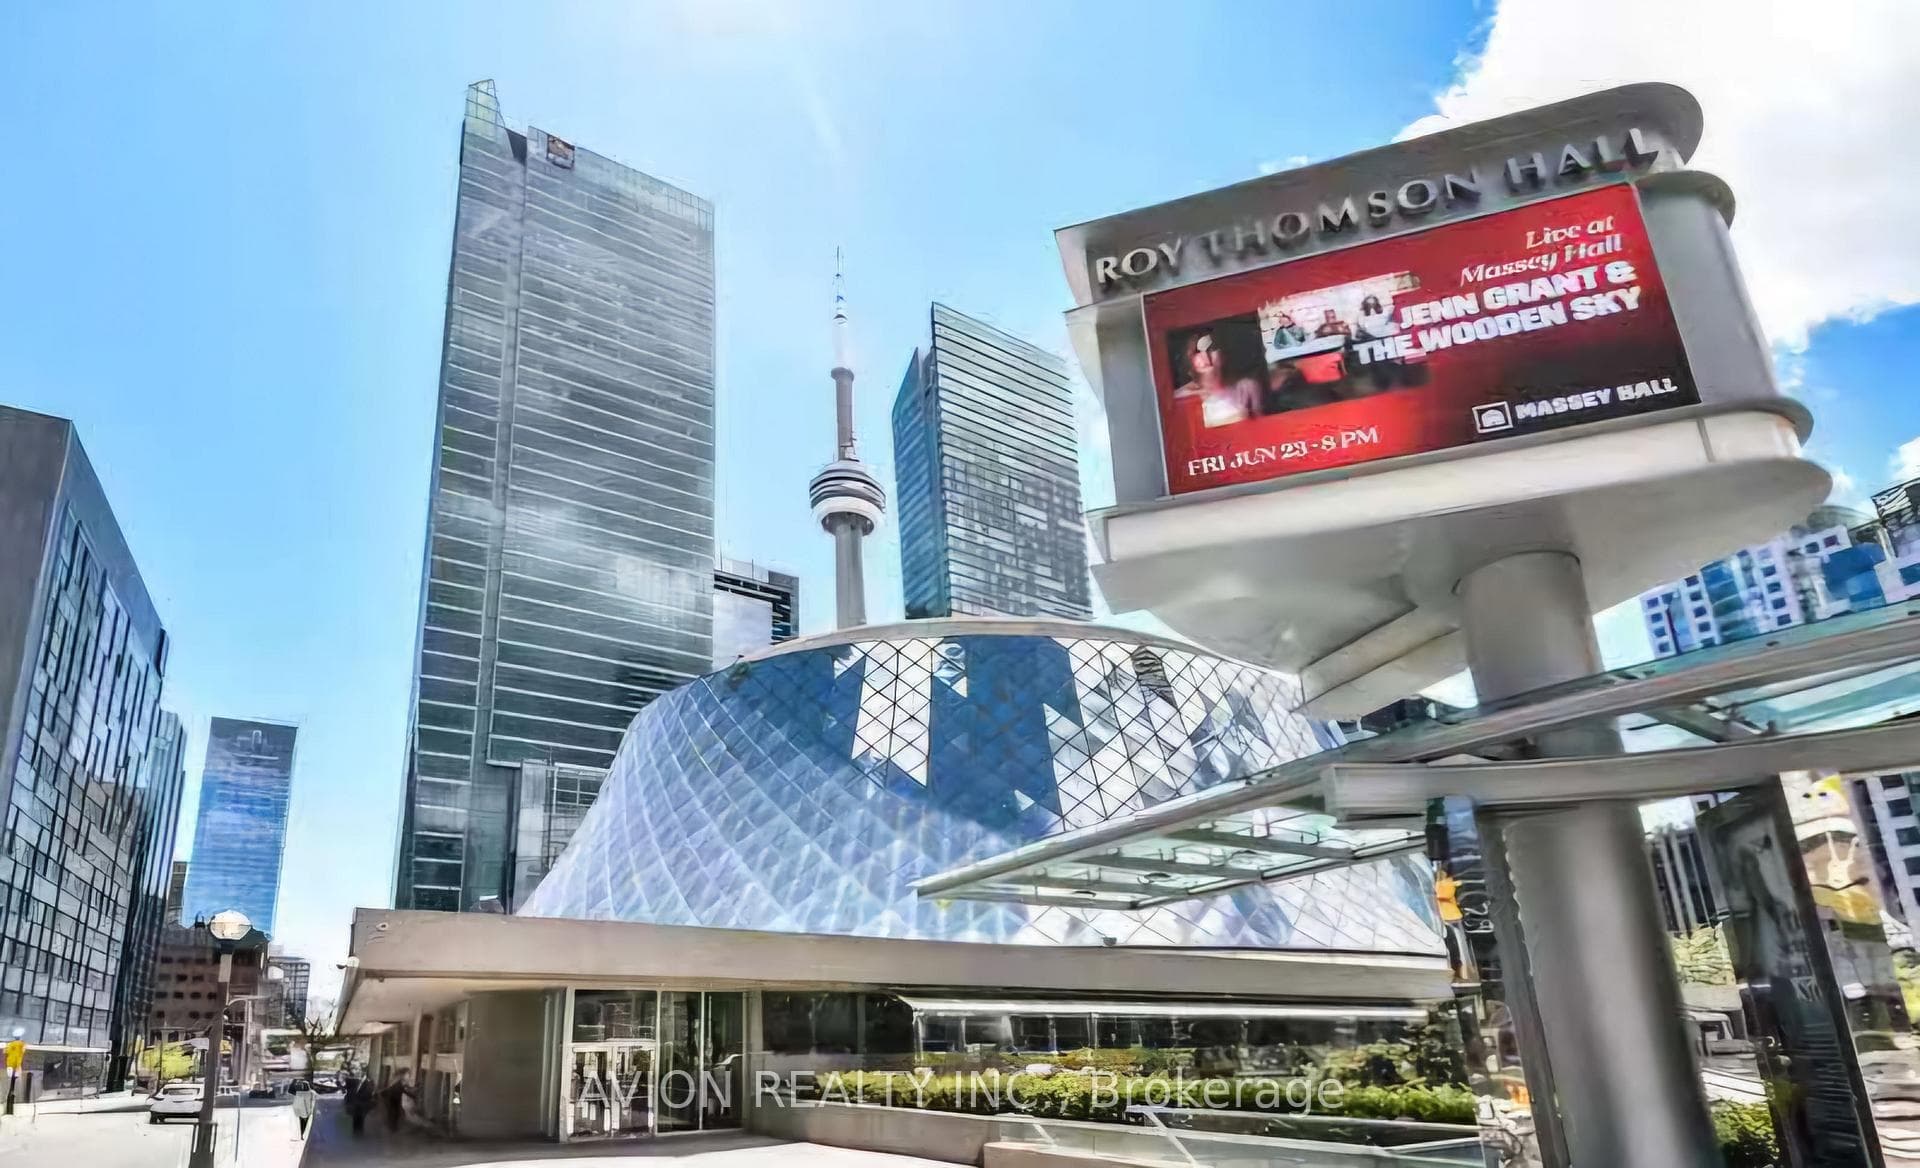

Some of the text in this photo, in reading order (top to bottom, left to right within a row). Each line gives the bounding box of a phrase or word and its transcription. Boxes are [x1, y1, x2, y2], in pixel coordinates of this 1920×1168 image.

[1096, 127, 1660, 284] ROY THOMSON HALL
[1526, 216, 1614, 250] Live at
[1460, 234, 1623, 287] Massey Hall
[1400, 260, 1639, 329] JENN GRANT &
[1353, 286, 1642, 365] THE WOODEN SKY
[1515, 377, 1679, 420] MASSEY HALL
[1188, 454, 1226, 476] FRI
[1229, 445, 1277, 469] JUN
[1341, 426, 1379, 449] PM
